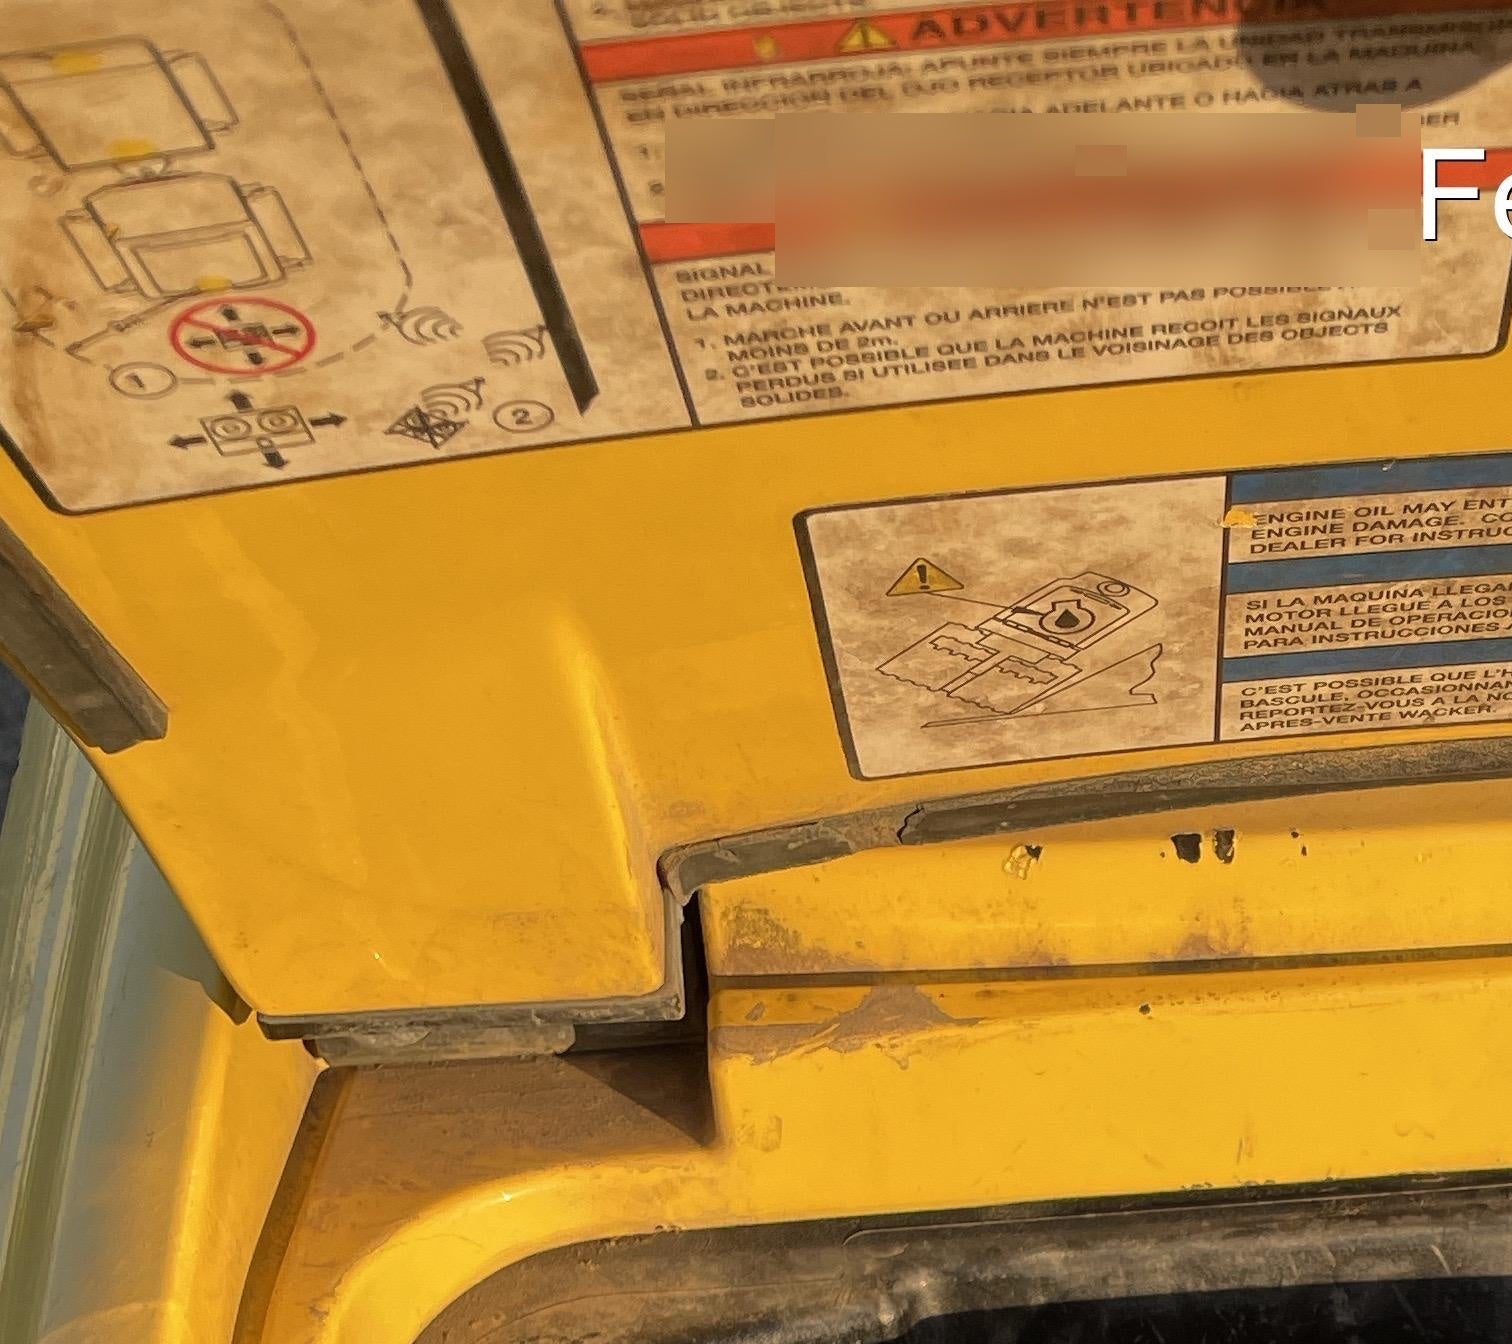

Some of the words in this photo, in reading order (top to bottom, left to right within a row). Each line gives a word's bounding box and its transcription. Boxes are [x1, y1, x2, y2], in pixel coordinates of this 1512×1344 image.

[675, 263, 770, 284] SIGNAL
[1256, 508, 1345, 525] ENGINE
[1347, 504, 1396, 518] OIL
[1403, 500, 1455, 514] MAY
[1252, 523, 1342, 539] ENGINE
[1353, 514, 1464, 532] DAMAGE.
[1250, 537, 1346, 554] DEALER
[1355, 533, 1403, 546] FOR
[1246, 598, 1267, 610] SI
[1276, 595, 1305, 608] LA
[1313, 586, 1424, 605] MAQUINA
[1244, 619, 1342, 636] MANUAL
[1351, 616, 1383, 628] DE
[1244, 634, 1304, 649] PARA
[1312, 621, 1499, 644] INSTRUCCIONES
[1241, 681, 1305, 696] C'EST
[1313, 672, 1422, 691] POSSIBLE
[1430, 669, 1476, 682] QUE
[1240, 697, 1424, 721] REPORTEZ-VOUS
[1431, 696, 1446, 707] A
[1453, 693, 1478, 705] LA
[1240, 710, 1391, 732] APRES-VENTE
[1398, 703, 1496, 720] WACKER.
